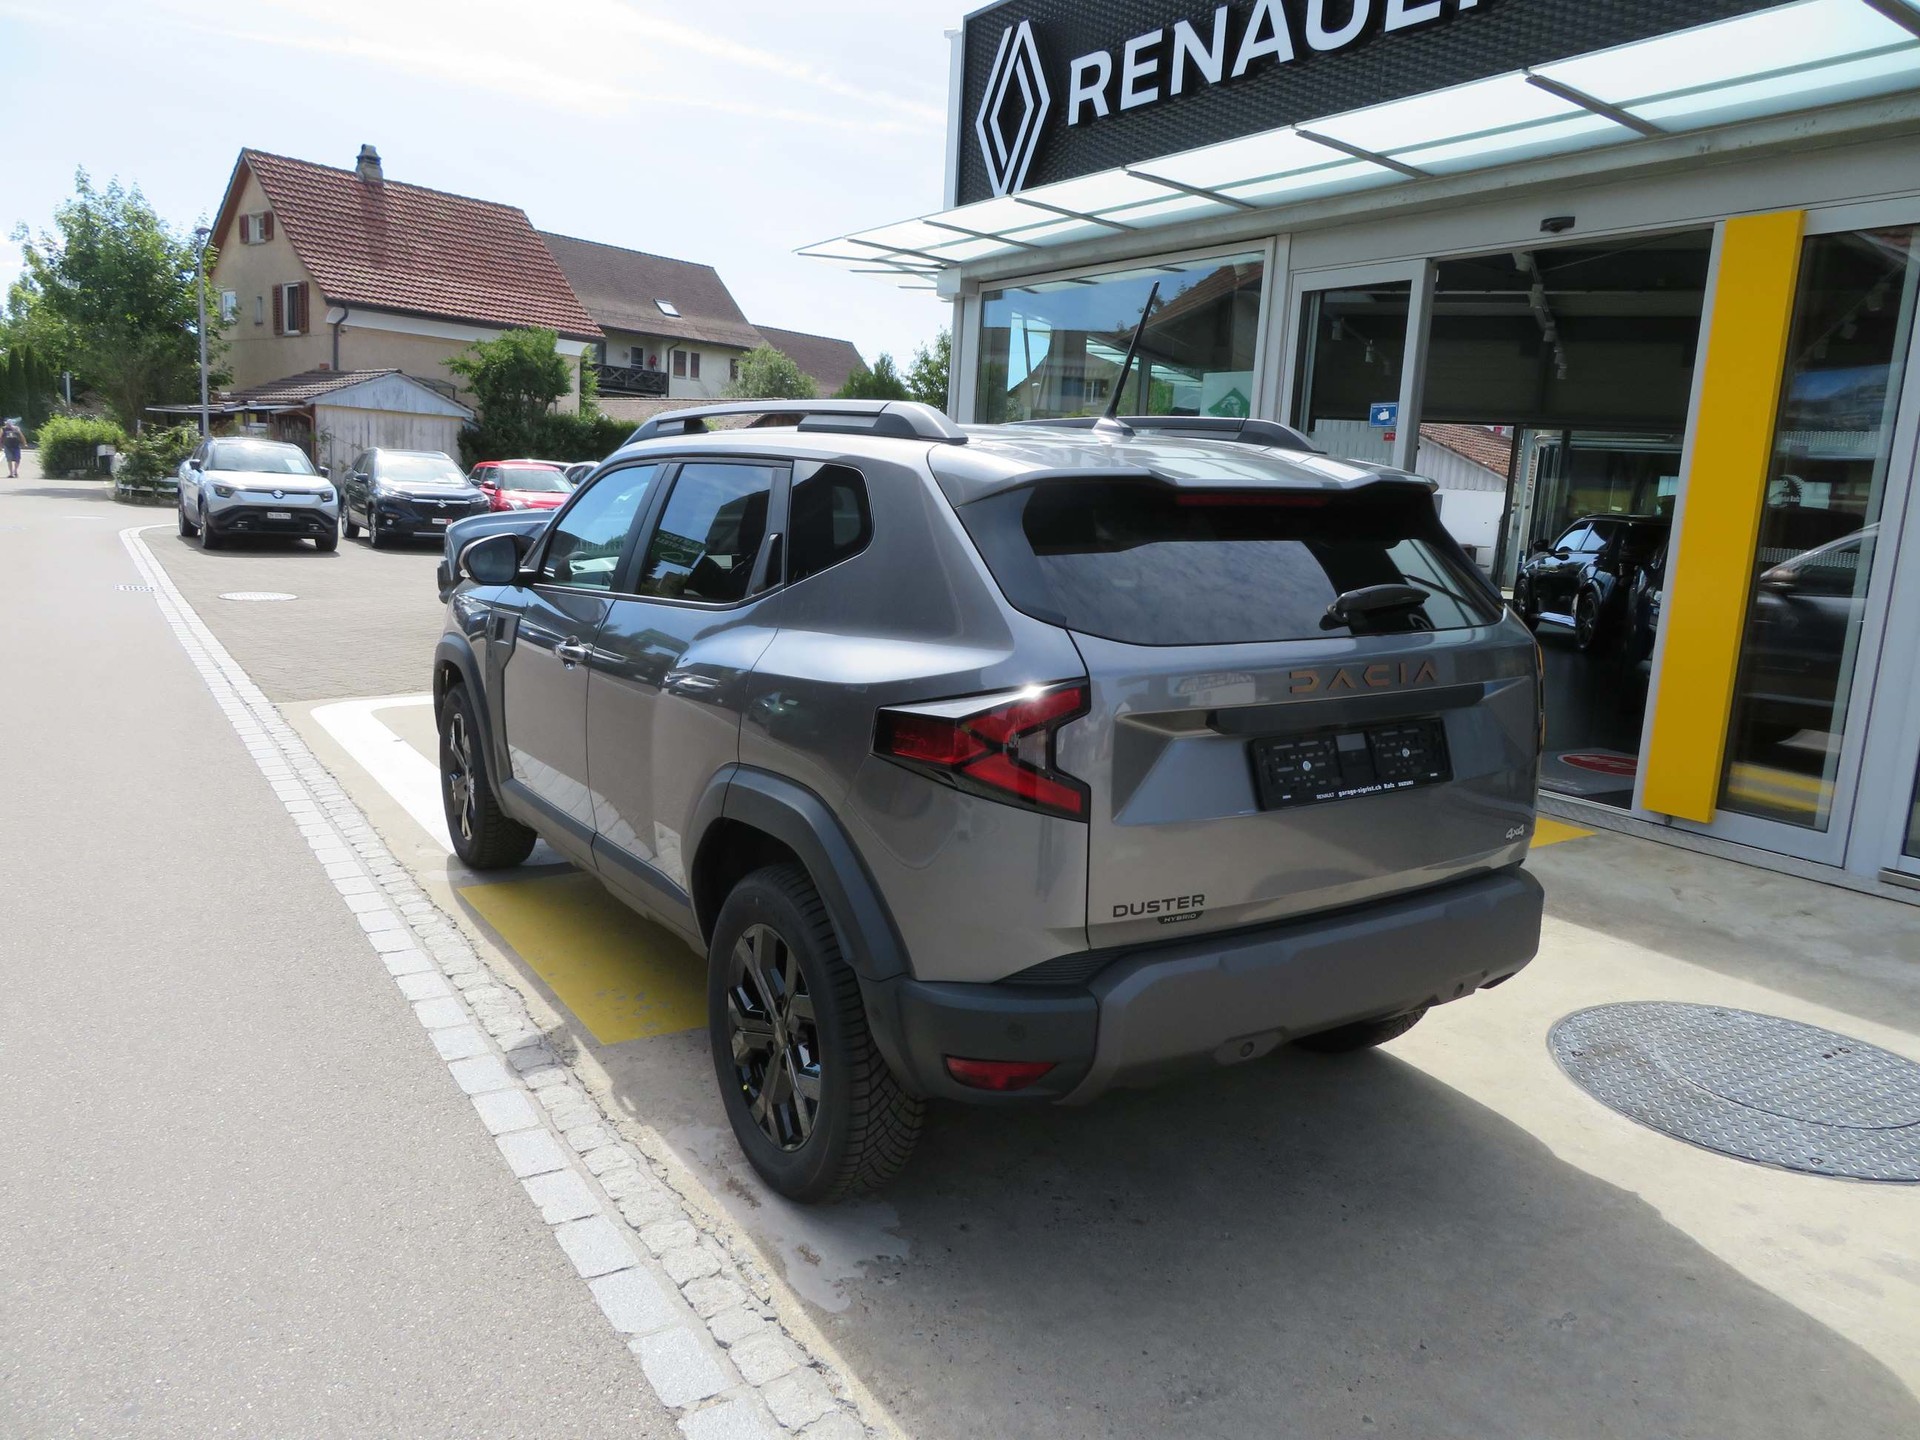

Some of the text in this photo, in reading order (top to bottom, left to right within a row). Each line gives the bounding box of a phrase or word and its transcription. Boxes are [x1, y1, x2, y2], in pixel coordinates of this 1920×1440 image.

[1067, 0, 1479, 126] RENAU
[1289, 660, 1438, 694] DACIA
[1505, 824, 1524, 839] 4x4
[1113, 893, 1205, 918] DUSTER
[1163, 913, 1197, 922] HYBRID
